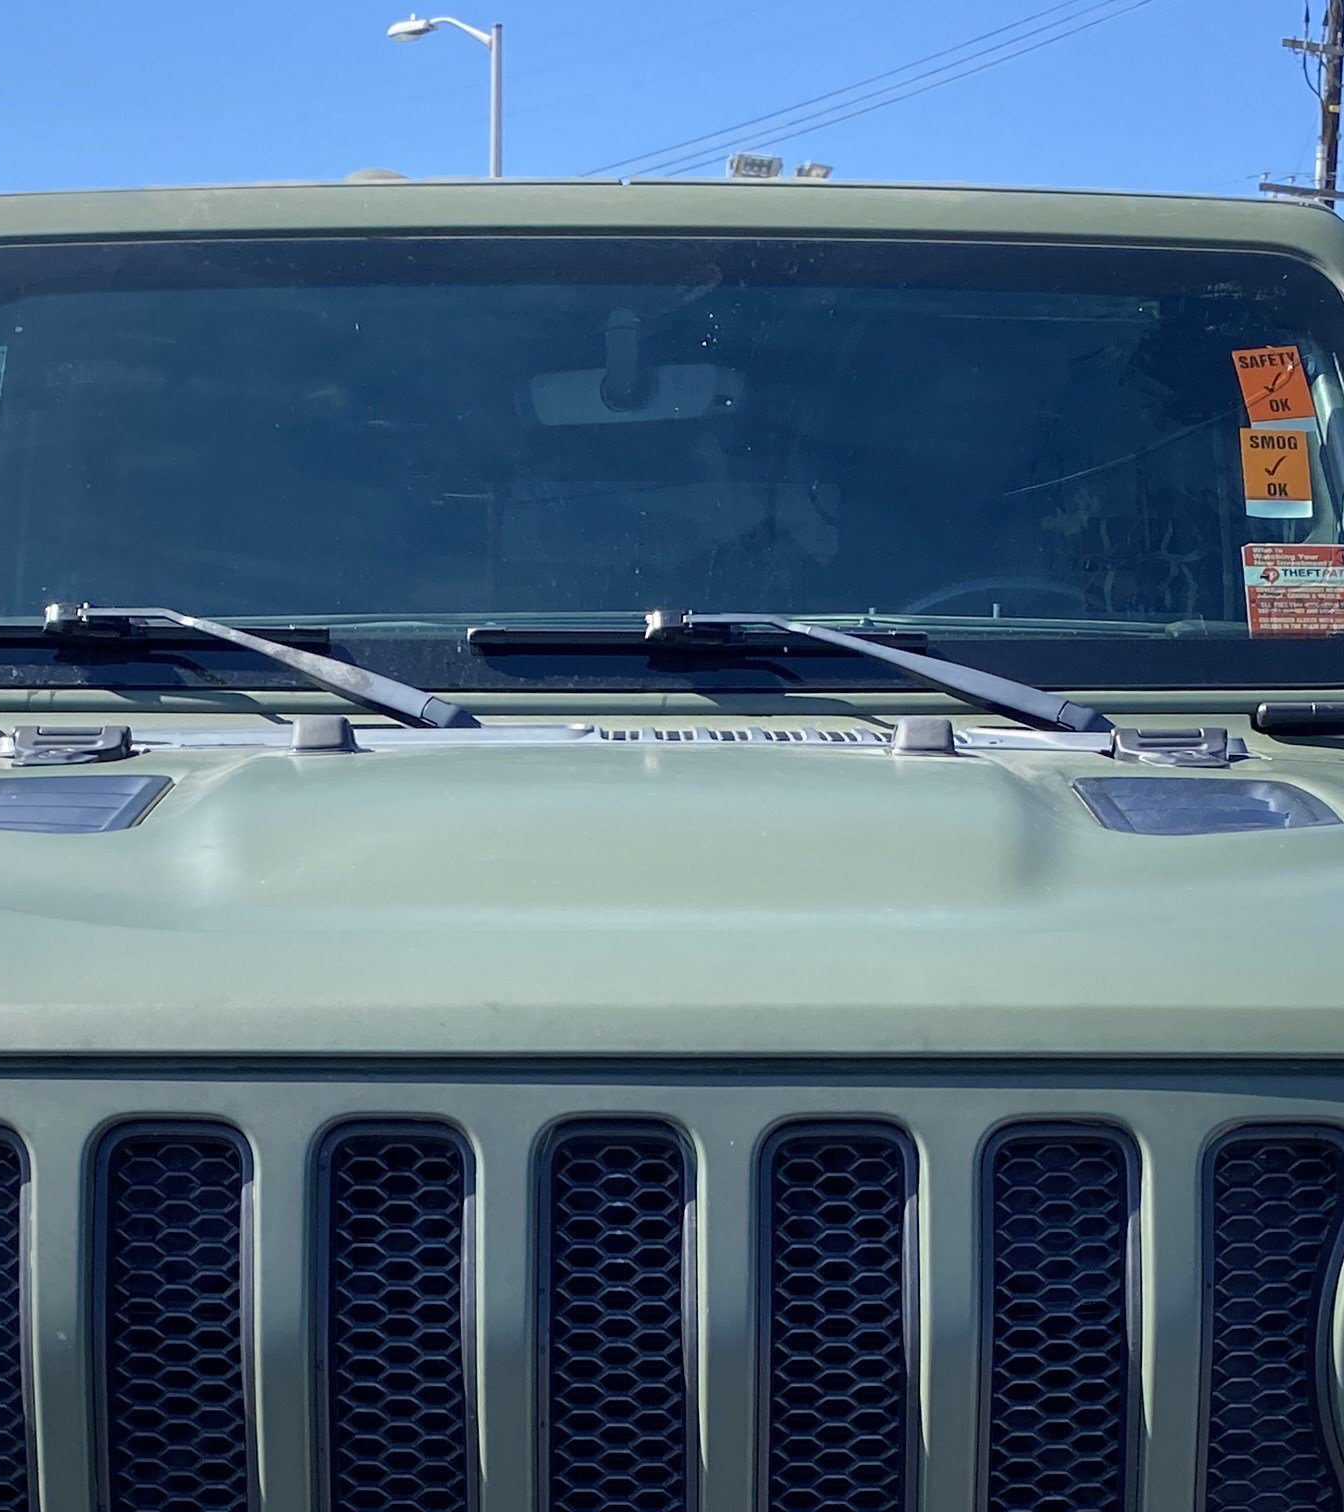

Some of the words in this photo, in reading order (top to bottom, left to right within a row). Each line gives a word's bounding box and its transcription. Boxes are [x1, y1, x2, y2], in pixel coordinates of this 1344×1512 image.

[1238, 352, 1295, 369] SAFETY
[1269, 398, 1292, 412] OK
[1249, 435, 1298, 450] SMOG
[1267, 482, 1288, 497] OK
